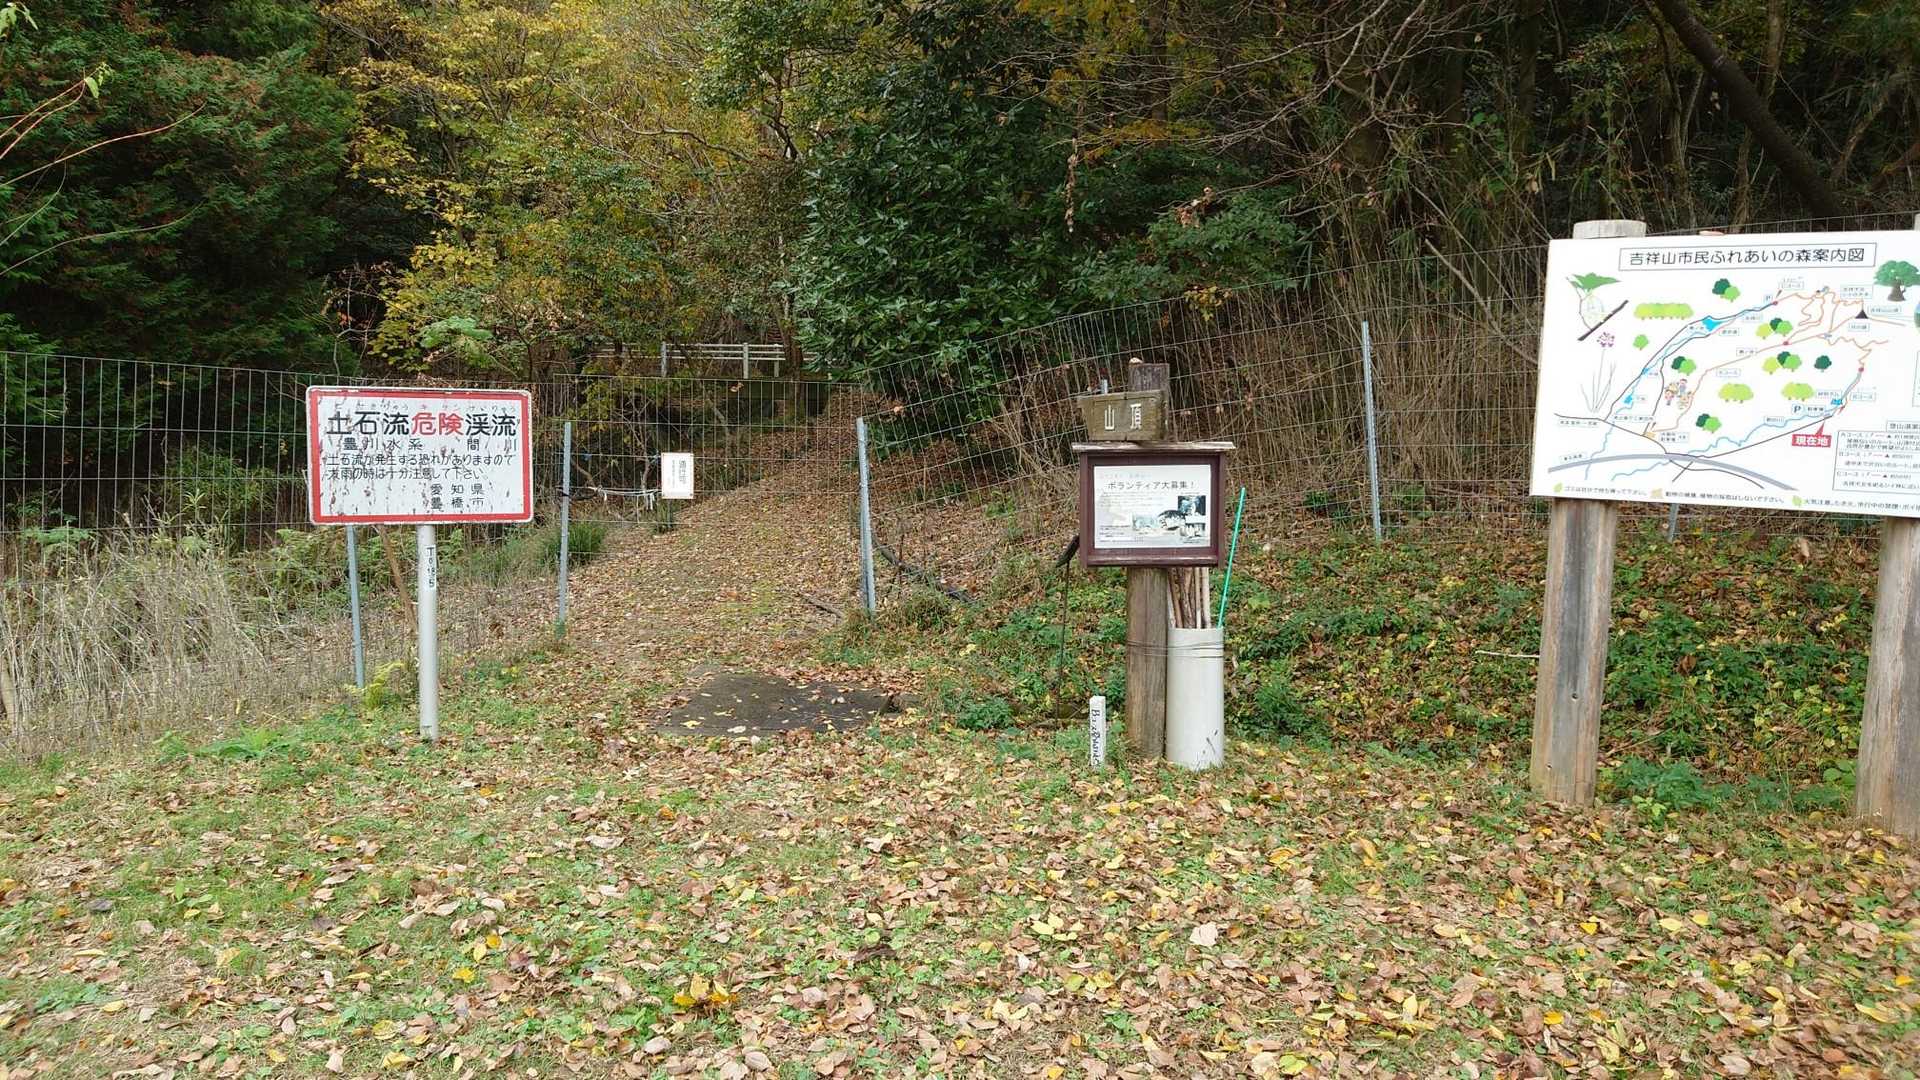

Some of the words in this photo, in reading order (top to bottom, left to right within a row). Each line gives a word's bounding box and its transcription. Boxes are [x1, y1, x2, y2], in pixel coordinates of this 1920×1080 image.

[1629, 247, 1865, 266] 吉祥山市民ふれあいの森案内図
[326, 411, 517, 436] 土石流危険渓流
[1104, 403, 1142, 430] 山頂
[430, 483, 485, 496] 愛知県
[430, 496, 485, 510] 豊橋市
